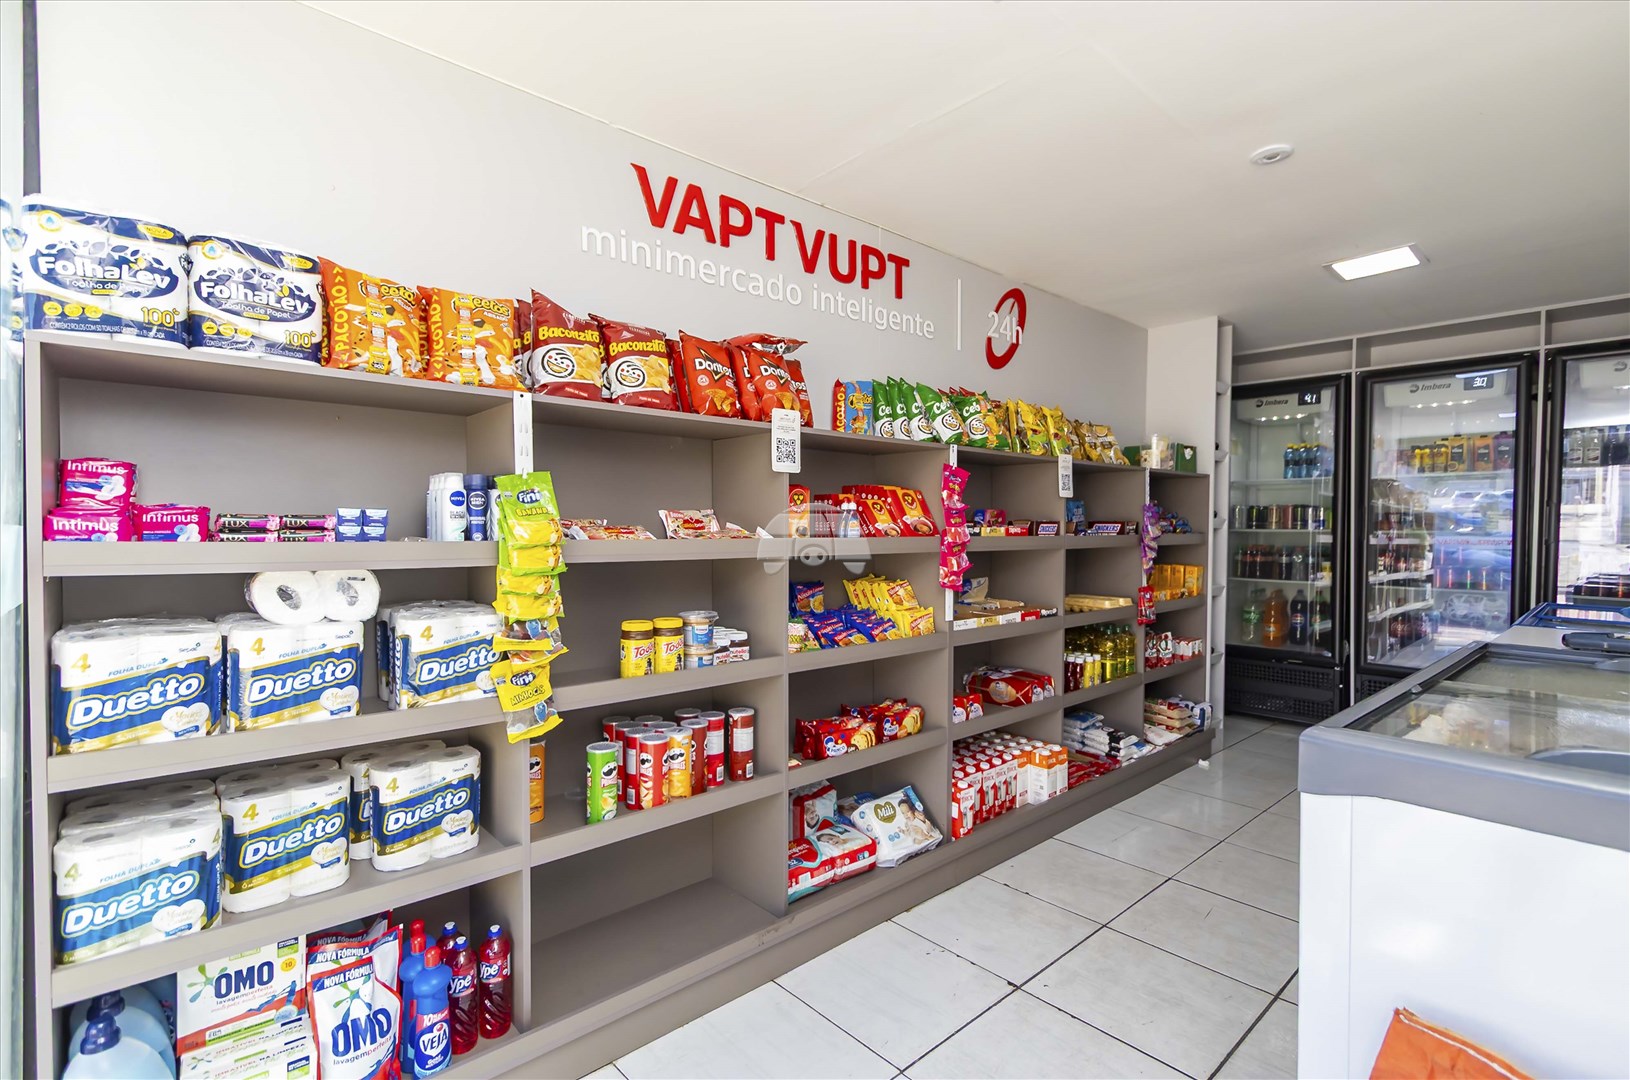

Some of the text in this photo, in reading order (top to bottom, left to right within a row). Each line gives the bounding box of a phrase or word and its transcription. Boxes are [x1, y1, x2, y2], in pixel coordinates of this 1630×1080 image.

[37, 256, 171, 289] FolhaLev
[581, 225, 936, 340] minimercado inteligente
[200, 281, 310, 314] FolhaLev
[987, 310, 1023, 346] 24h
[1420, 383, 1452, 392] Imbera
[67, 460, 126, 475] Intimus
[53, 518, 119, 532] Intimus
[142, 512, 199, 524] Intimus
[225, 520, 249, 528] LUX
[286, 519, 308, 527] LUX
[420, 625, 433, 641] 4
[250, 637, 264, 656] 4
[71, 653, 90, 673] 4
[420, 648, 500, 682] Duetto
[249, 662, 353, 703] Duetto
[72, 678, 199, 726] Duetto
[386, 777, 399, 793] 4
[242, 803, 258, 821] 4
[387, 791, 467, 832] Duetto
[244, 816, 342, 864] Duetto
[65, 863, 79, 882] 4
[65, 875, 194, 934] Duetto
[315, 946, 370, 963] NOVA FÓRMULA
[214, 960, 274, 999] OMO
[323, 974, 345, 989] NOVA
[332, 1008, 392, 1058] OMO
[422, 1028, 448, 1052] VEJA
